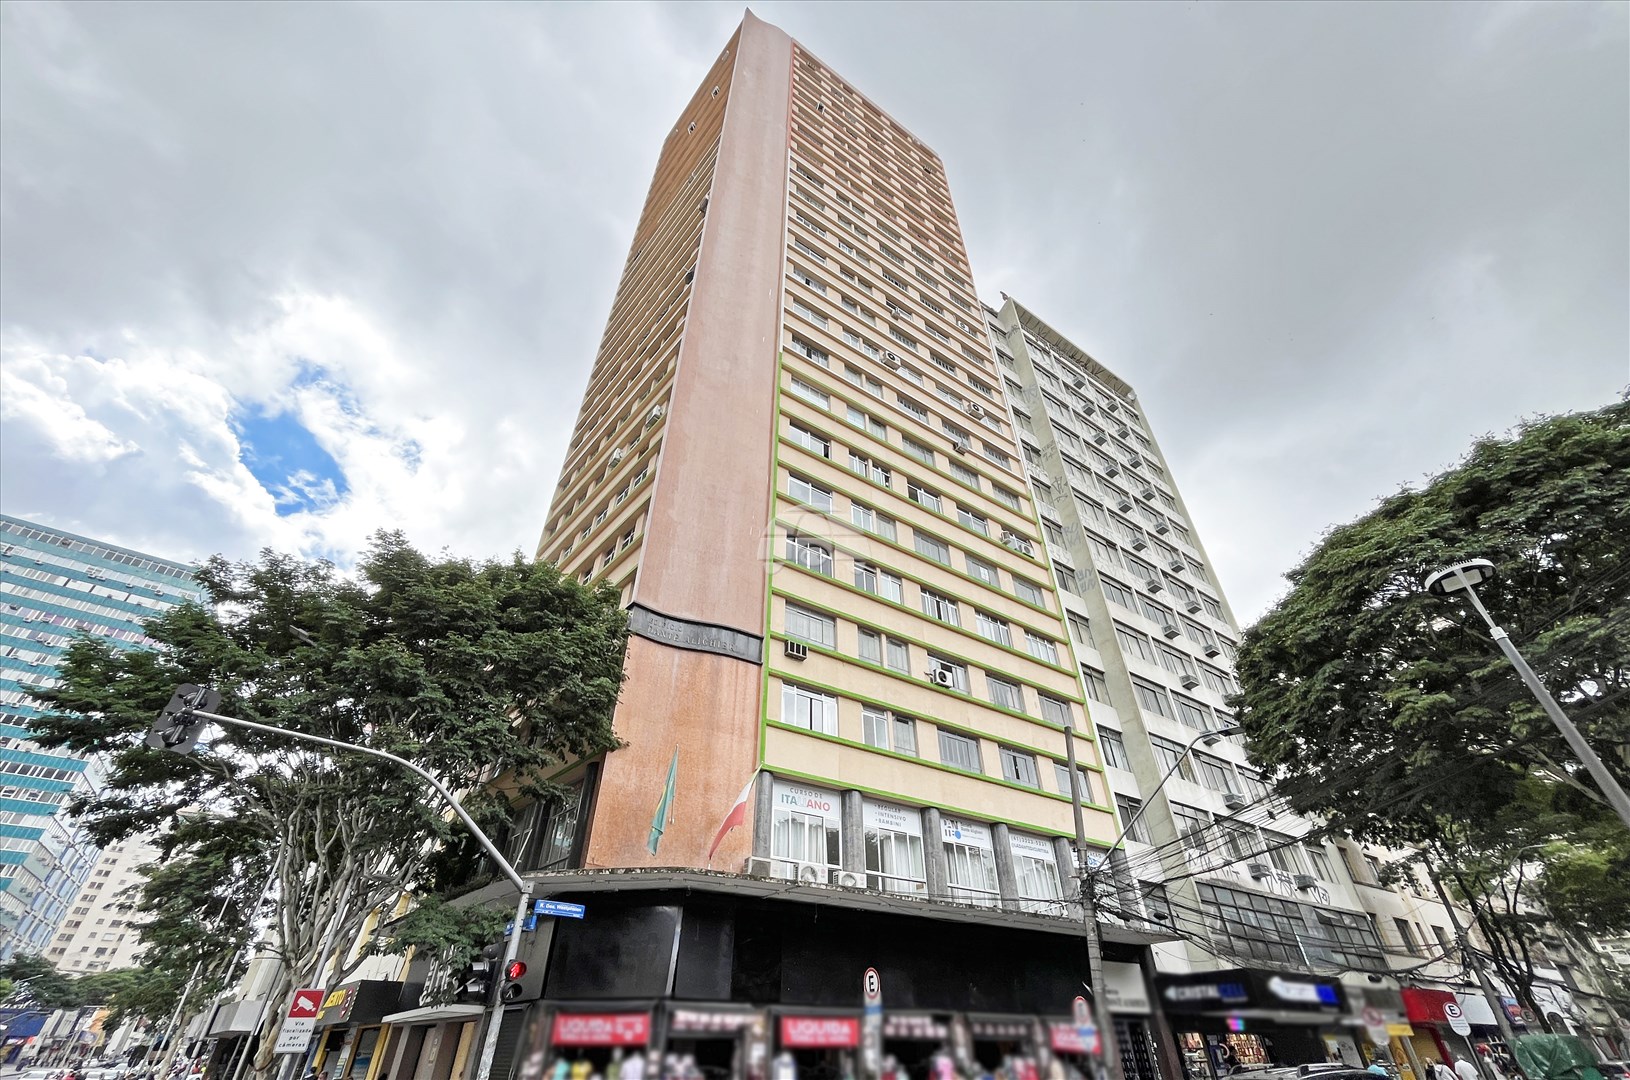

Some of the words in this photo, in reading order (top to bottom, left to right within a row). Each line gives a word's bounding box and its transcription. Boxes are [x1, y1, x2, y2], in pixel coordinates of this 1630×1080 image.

[790, 787, 813, 797] CURSO
[877, 811, 907, 822] INTENSIVO
[868, 975, 875, 993] E
[788, 1019, 851, 1034] LIQUIDA
